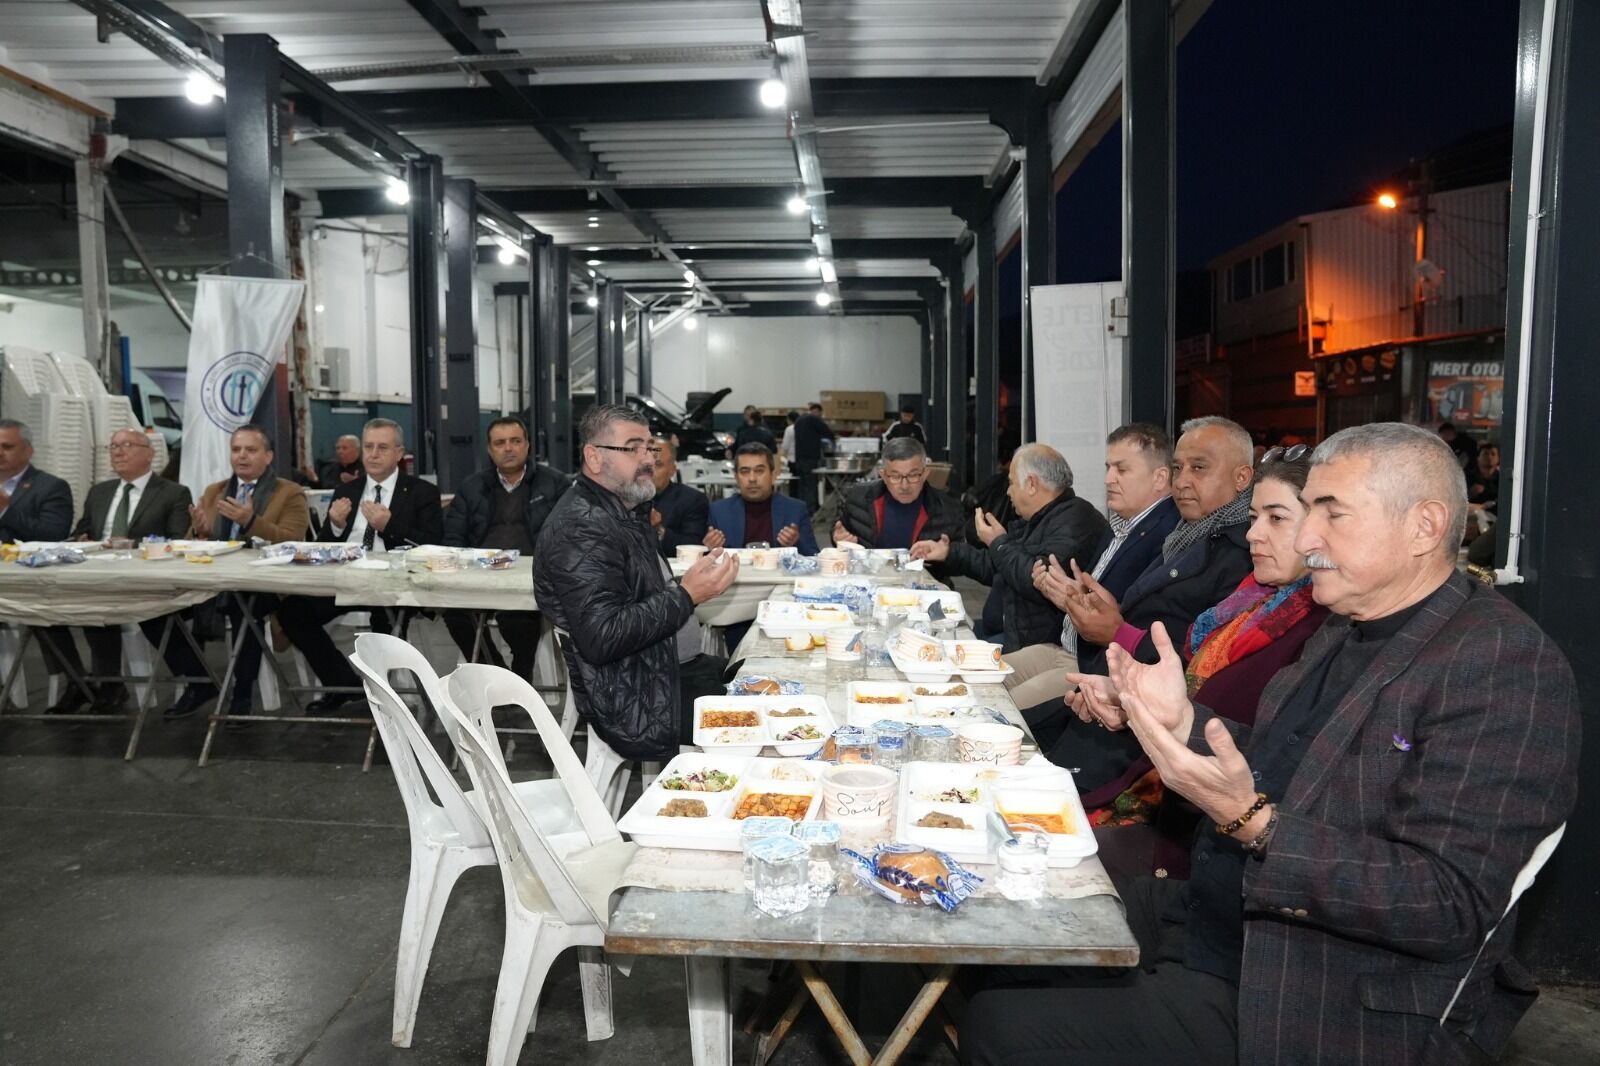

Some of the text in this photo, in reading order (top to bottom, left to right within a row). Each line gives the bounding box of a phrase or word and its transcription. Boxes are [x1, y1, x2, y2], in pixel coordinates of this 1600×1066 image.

[1431, 362, 1469, 376] MERT
[1472, 362, 1500, 376] OTO
[961, 741, 1009, 765] Soup
[836, 792, 890, 817] Soup
